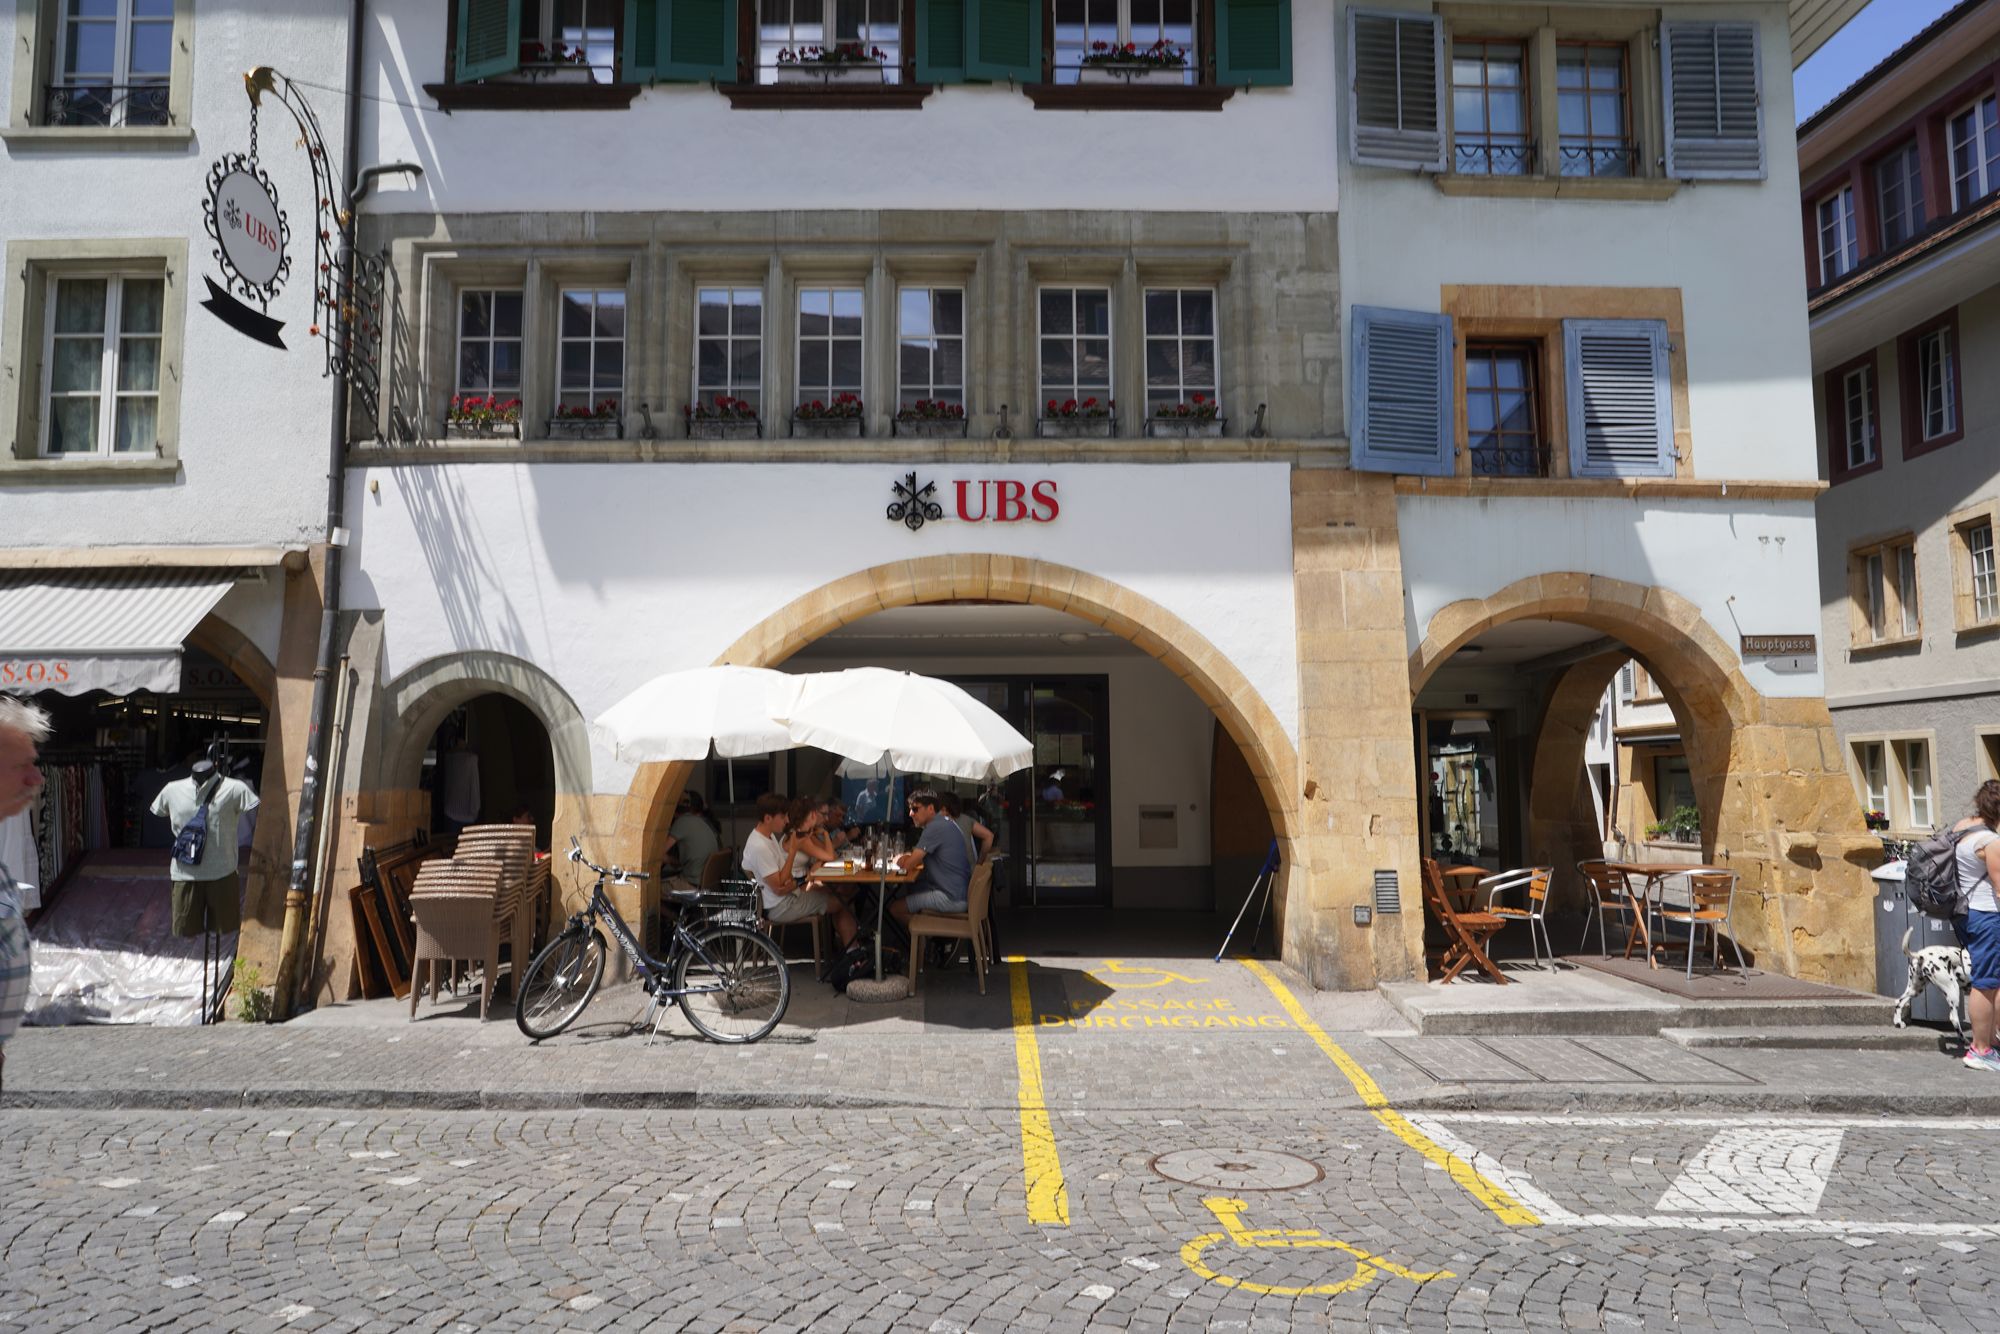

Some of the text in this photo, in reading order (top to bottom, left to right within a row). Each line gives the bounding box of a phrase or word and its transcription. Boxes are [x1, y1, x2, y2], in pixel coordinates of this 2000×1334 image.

[245, 211, 277, 253] UBS
[952, 480, 1060, 522] UBS
[1746, 637, 1811, 652] Hauptgasse
[2, 662, 69, 683] S.O.S
[1071, 998, 1237, 1011] PASSAGE
[1039, 1014, 1289, 1028] DURCHGANG
